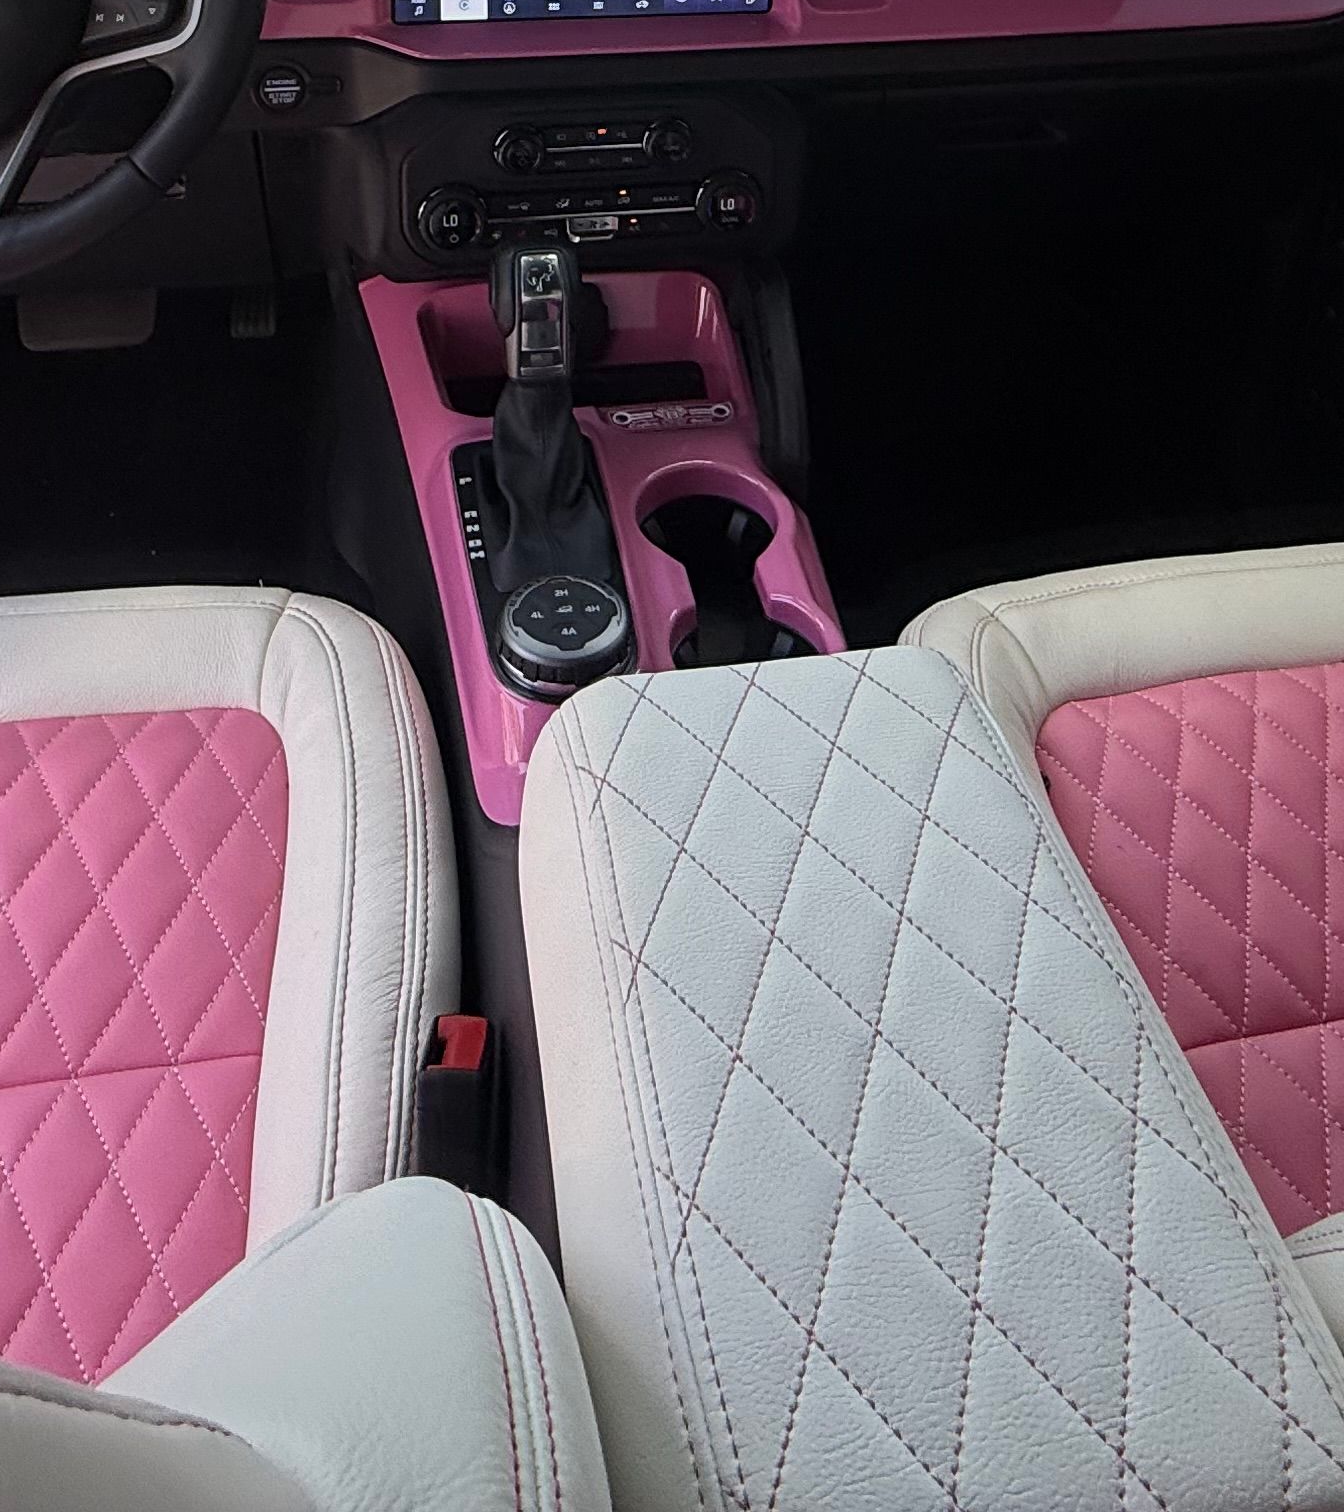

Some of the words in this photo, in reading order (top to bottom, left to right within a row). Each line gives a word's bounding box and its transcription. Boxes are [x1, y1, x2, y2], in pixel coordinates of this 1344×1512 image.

[459, 477, 472, 485] P
[554, 589, 568, 597] 2H
[530, 611, 544, 619] 4L
[561, 627, 577, 635] 4A
